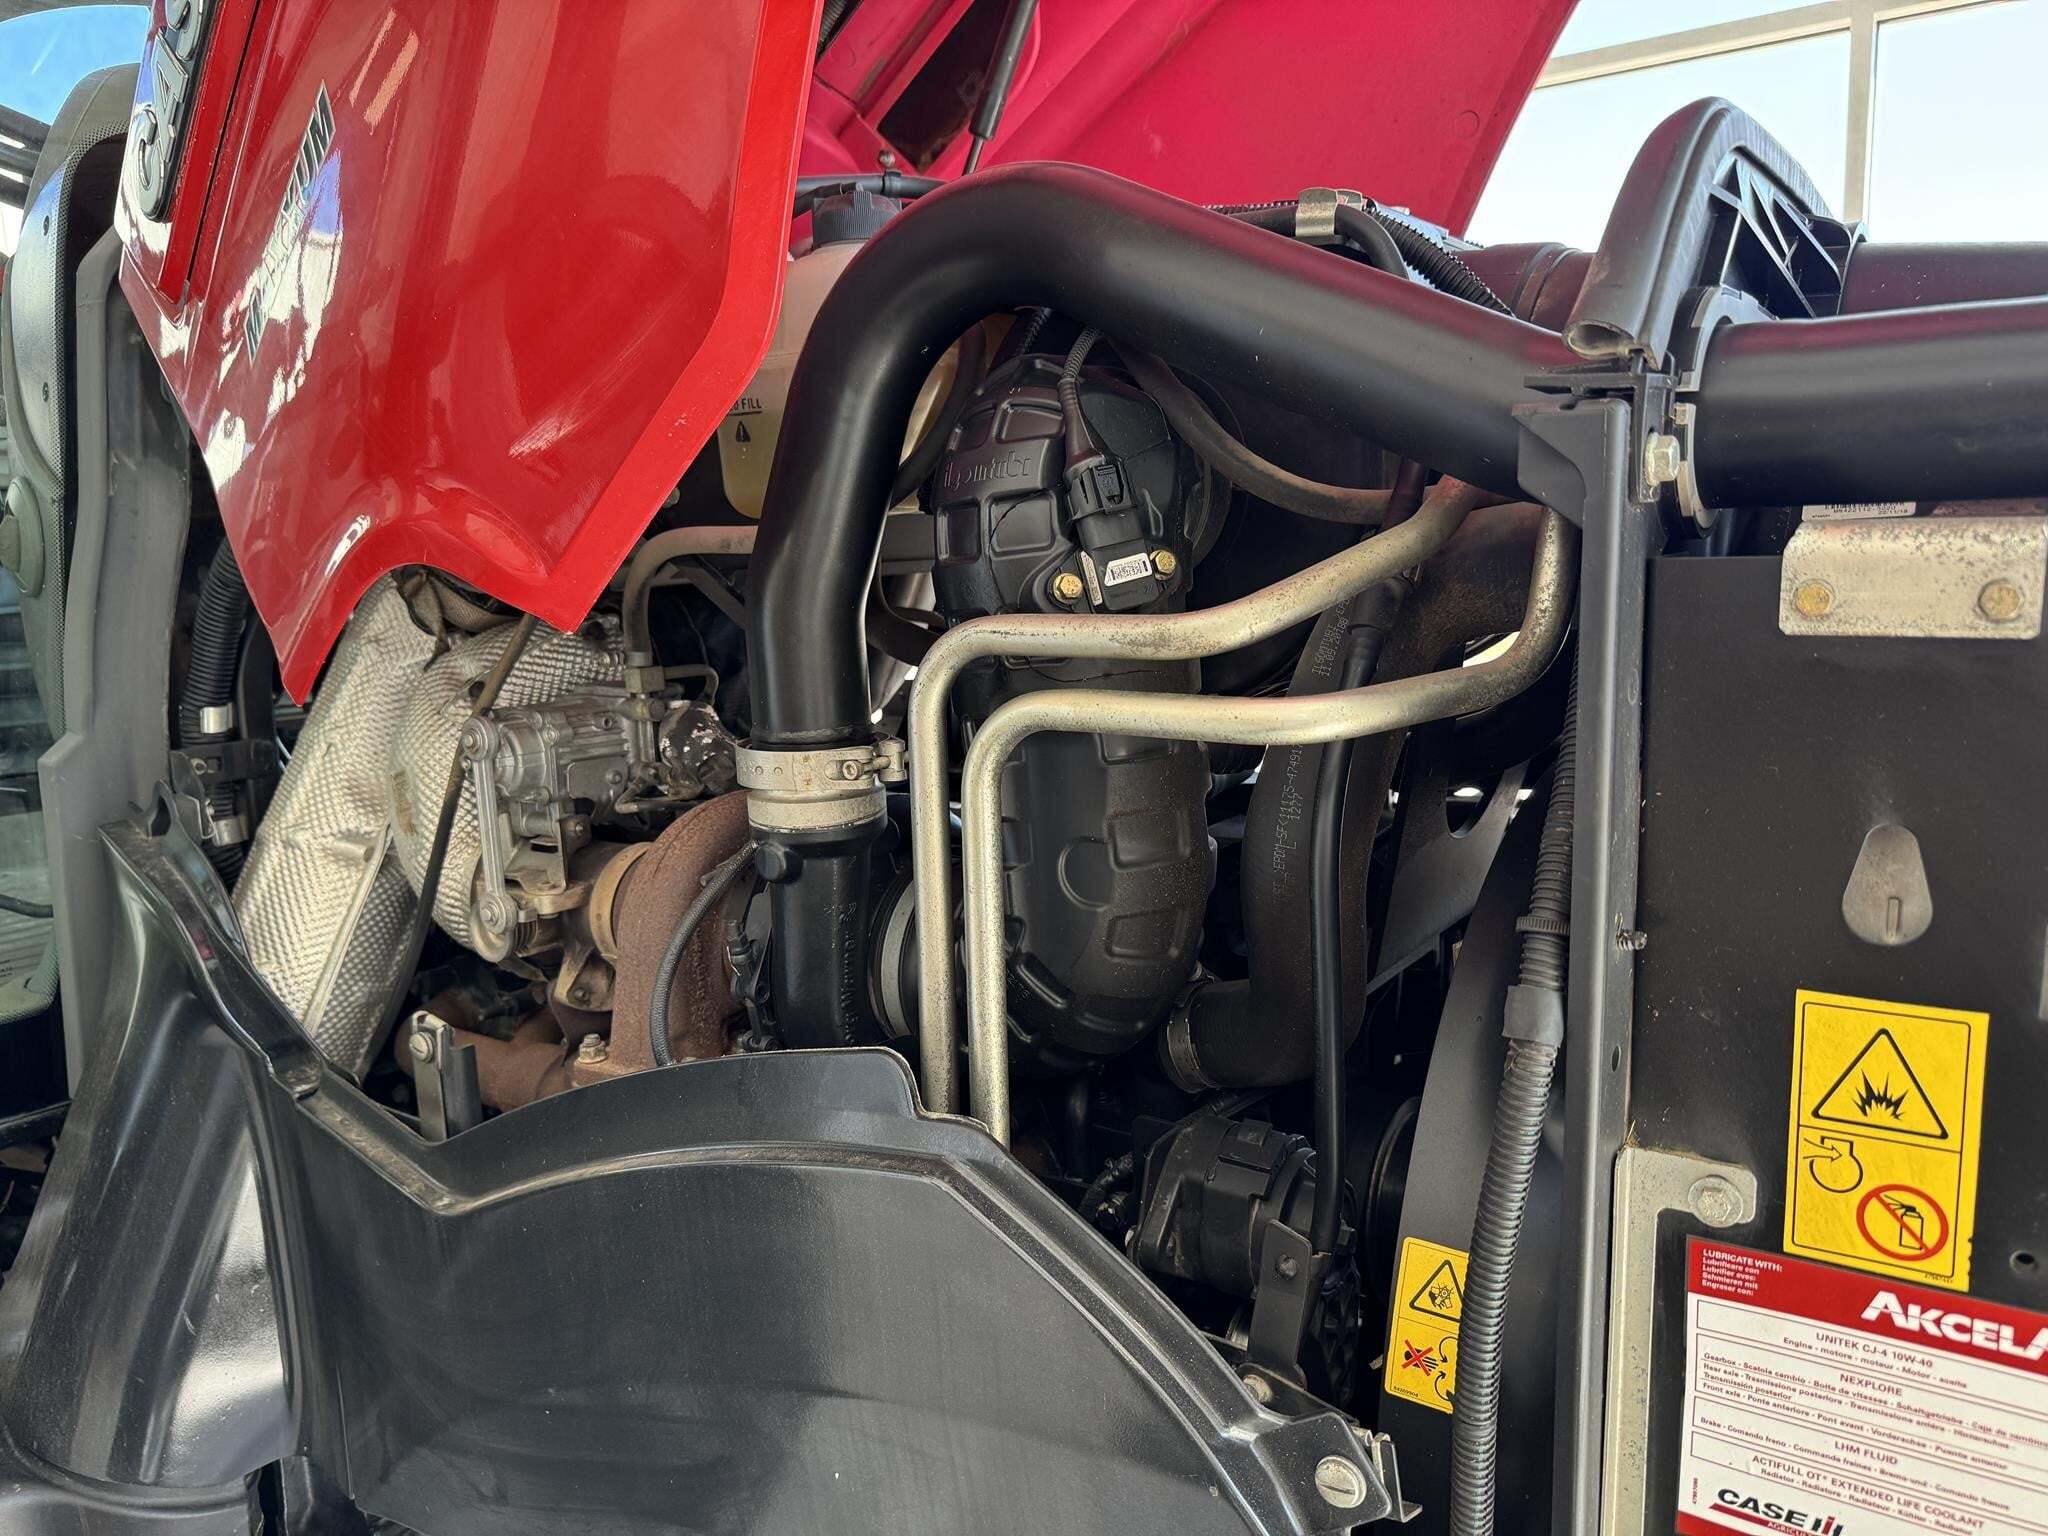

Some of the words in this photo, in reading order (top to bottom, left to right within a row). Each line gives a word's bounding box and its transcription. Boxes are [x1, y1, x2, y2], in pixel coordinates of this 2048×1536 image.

[741, 398, 762, 409] FILL
[1702, 1248, 1754, 1267] LUBRICATE
[1754, 1259, 1783, 1273] WITH:
[1783, 1337, 1813, 1351] Engine
[1902, 1366, 1931, 1379] Motor
[1816, 1332, 1860, 1351] UNITEK
[1862, 1344, 1888, 1358] CJ-4
[1892, 1350, 1934, 1368] 10W-40
[1703, 1363, 1722, 1373] Rear
[1723, 1367, 1740, 1378] axle
[1703, 1352, 1737, 1366] Gearbox
[1743, 1362, 1773, 1375] Scatola
[1775, 1370, 1806, 1384] cambio
[1838, 1387, 1850, 1395] de
[1852, 1391, 1888, 1405] vitesses
[1840, 1374, 1903, 1396] NEXPLORE
[1702, 1382, 1724, 1394] Front
[1725, 1388, 1741, 1398] axle
[1747, 1395, 1771, 1407] Ponte
[1772, 1402, 1810, 1417] anteriore
[1817, 1413, 1837, 1425] Pont
[1839, 1420, 1864, 1432] avant
[1755, 1386, 1792, 1401] posterior
[1700, 1416, 1722, 1429] Brake
[1727, 1424, 1765, 1442] Comando
[1765, 1436, 1787, 1448] freno
[1834, 1440, 1861, 1455] LHM
[1863, 1449, 1898, 1465] FLUID
[1752, 1454, 1804, 1477] ACTIFULL
[1831, 1477, 1894, 1502] EXTENDED
[1896, 1497, 1922, 1511] LIFE
[1924, 1504, 1985, 1529] COOLANT
[1717, 1488, 1809, 1528] CASE
